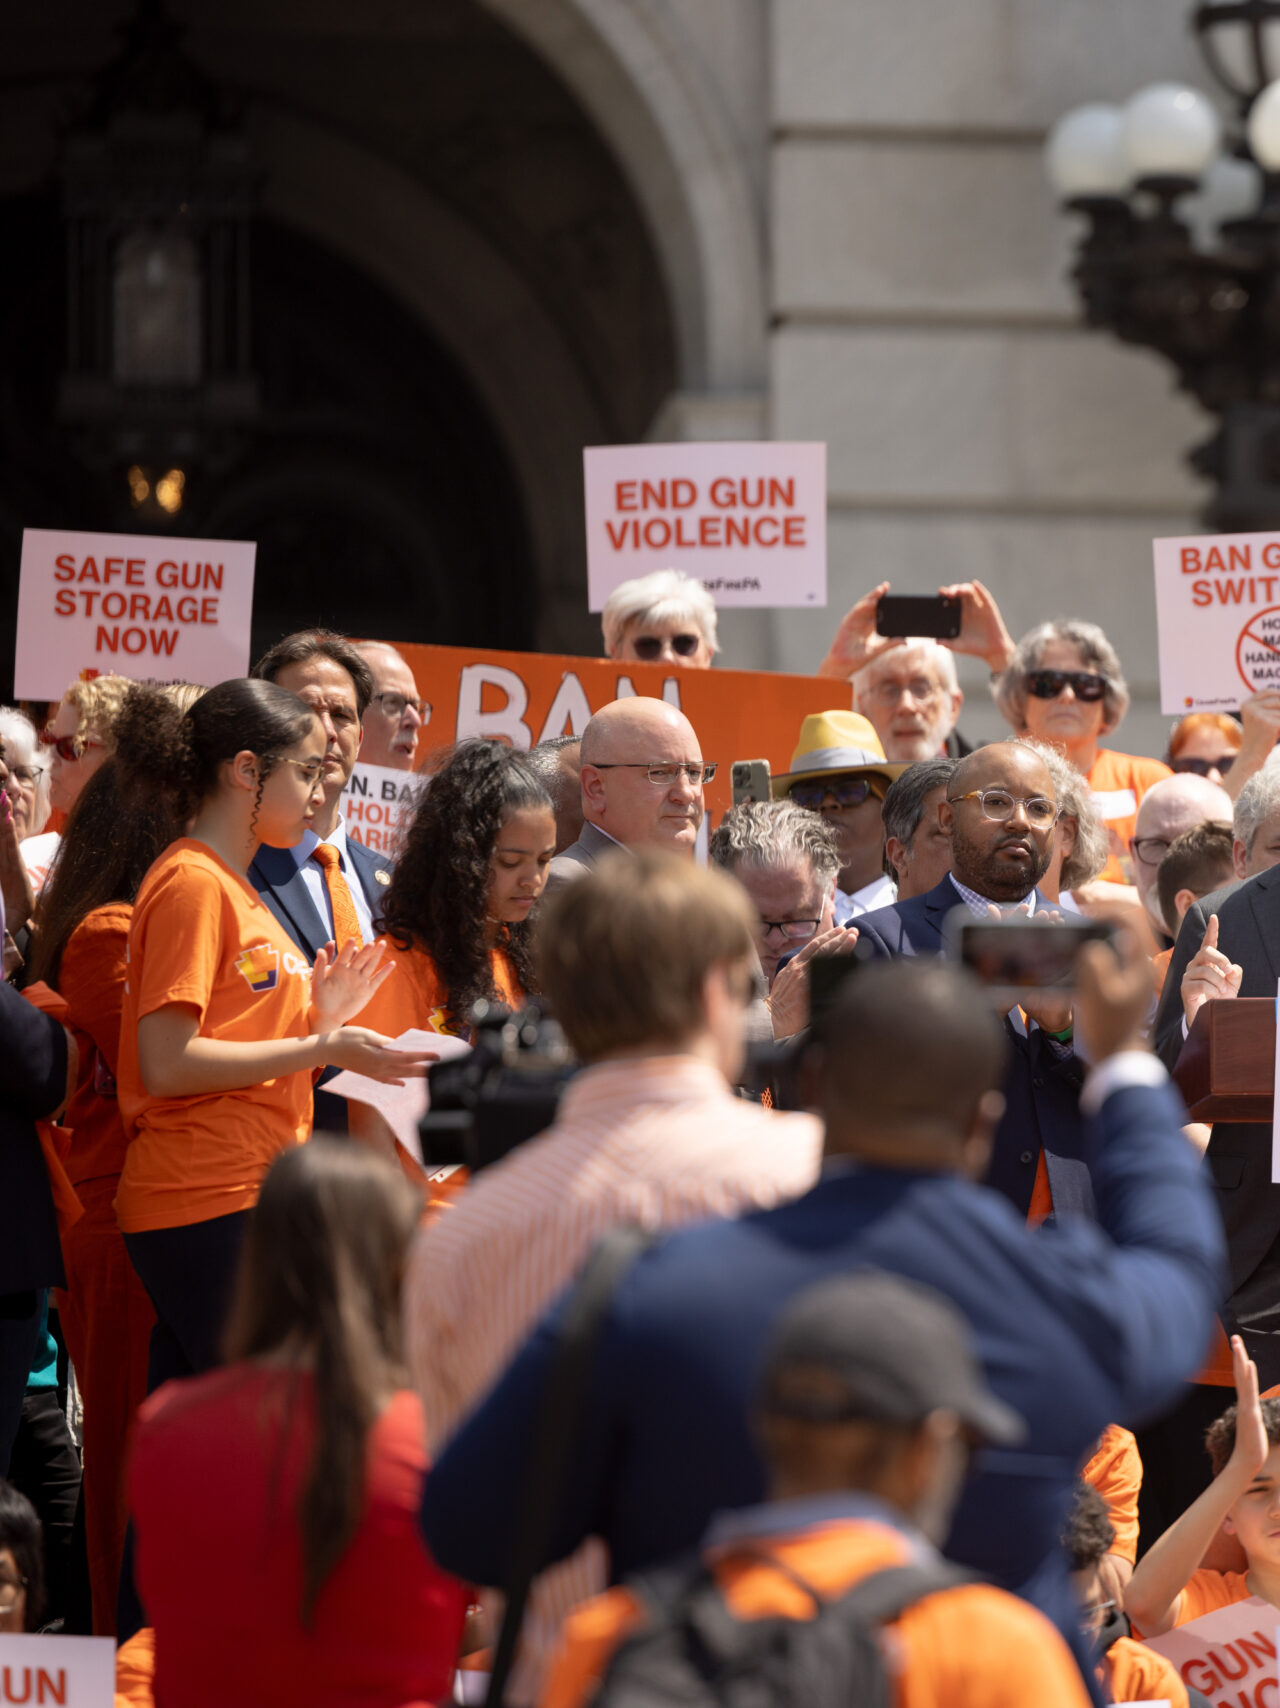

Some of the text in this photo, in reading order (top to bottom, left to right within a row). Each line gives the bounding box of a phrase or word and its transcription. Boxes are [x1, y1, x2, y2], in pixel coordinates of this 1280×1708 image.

[615, 477, 796, 513] END GUN
[605, 515, 807, 552] VIOLENCE
[54, 554, 224, 591] SAFE GUN
[1180, 544, 1252, 574] BAN
[54, 589, 219, 625] STORAGE
[95, 624, 180, 657] NOW
[1181, 1631, 1277, 1697] GUN
[2, 1666, 66, 1706] UN
